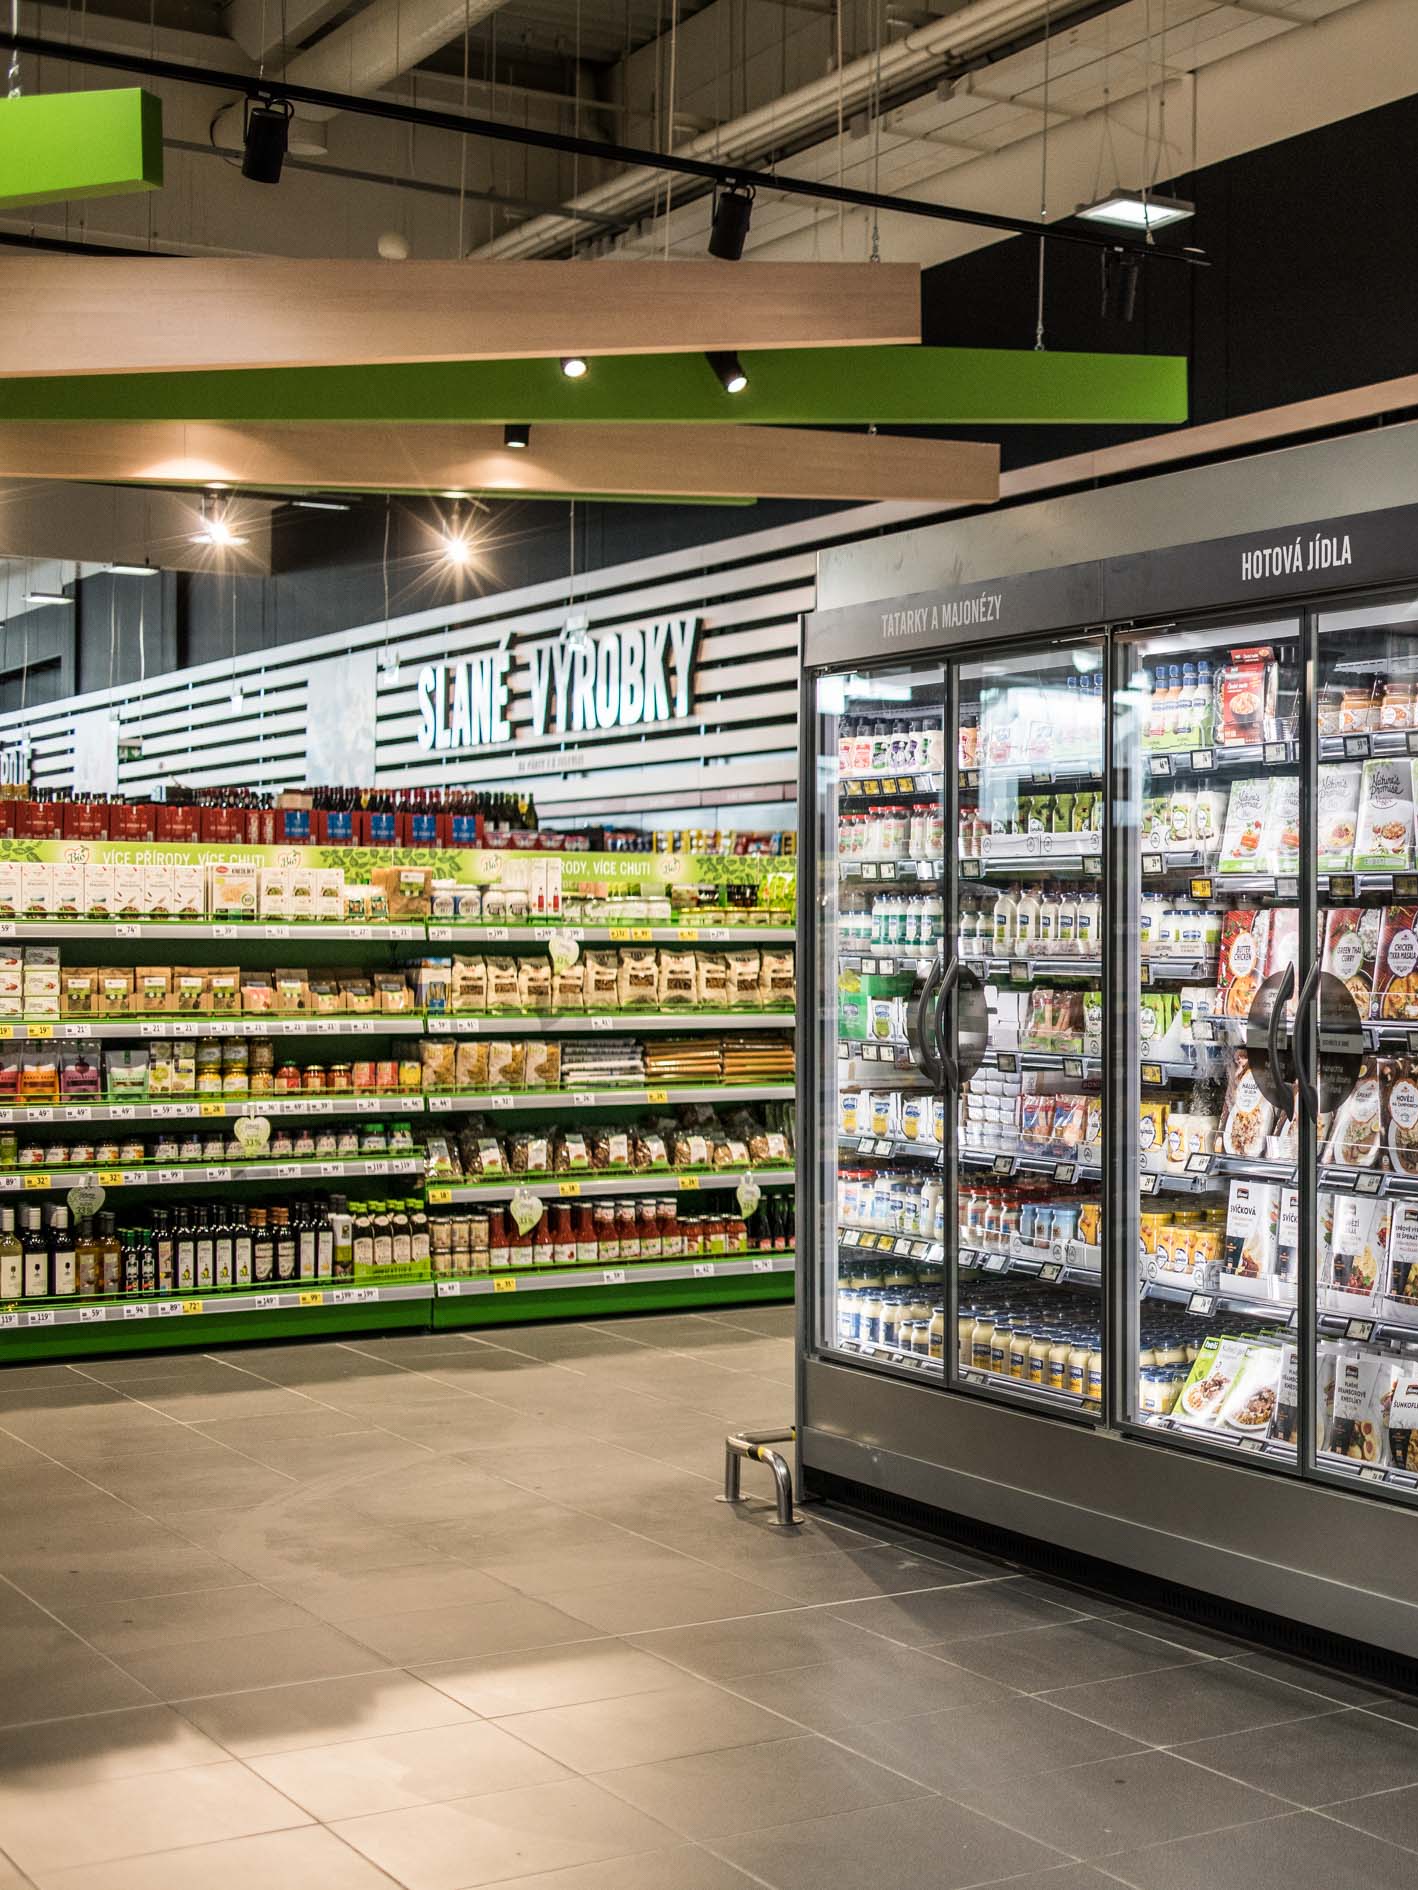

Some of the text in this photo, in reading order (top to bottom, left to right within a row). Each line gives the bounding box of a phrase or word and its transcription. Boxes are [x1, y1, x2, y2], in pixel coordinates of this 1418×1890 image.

[1242, 533, 1352, 580] HOTOVÁ JÍDLA
[881, 591, 1002, 637] TATARKY A MAJONÉZY
[417, 618, 700, 750] SLANÉ VÝROBKY
[103, 848, 131, 866] VÍCE
[198, 849, 225, 865] VÍCE
[593, 858, 617, 876] VÍCE
[619, 860, 651, 877] CHUTI
[1394, 943, 1414, 952] CHICKEN
[1230, 1204, 1256, 1216] SVÍČKOVÁ
[1282, 1213, 1298, 1224] SVÍČK
